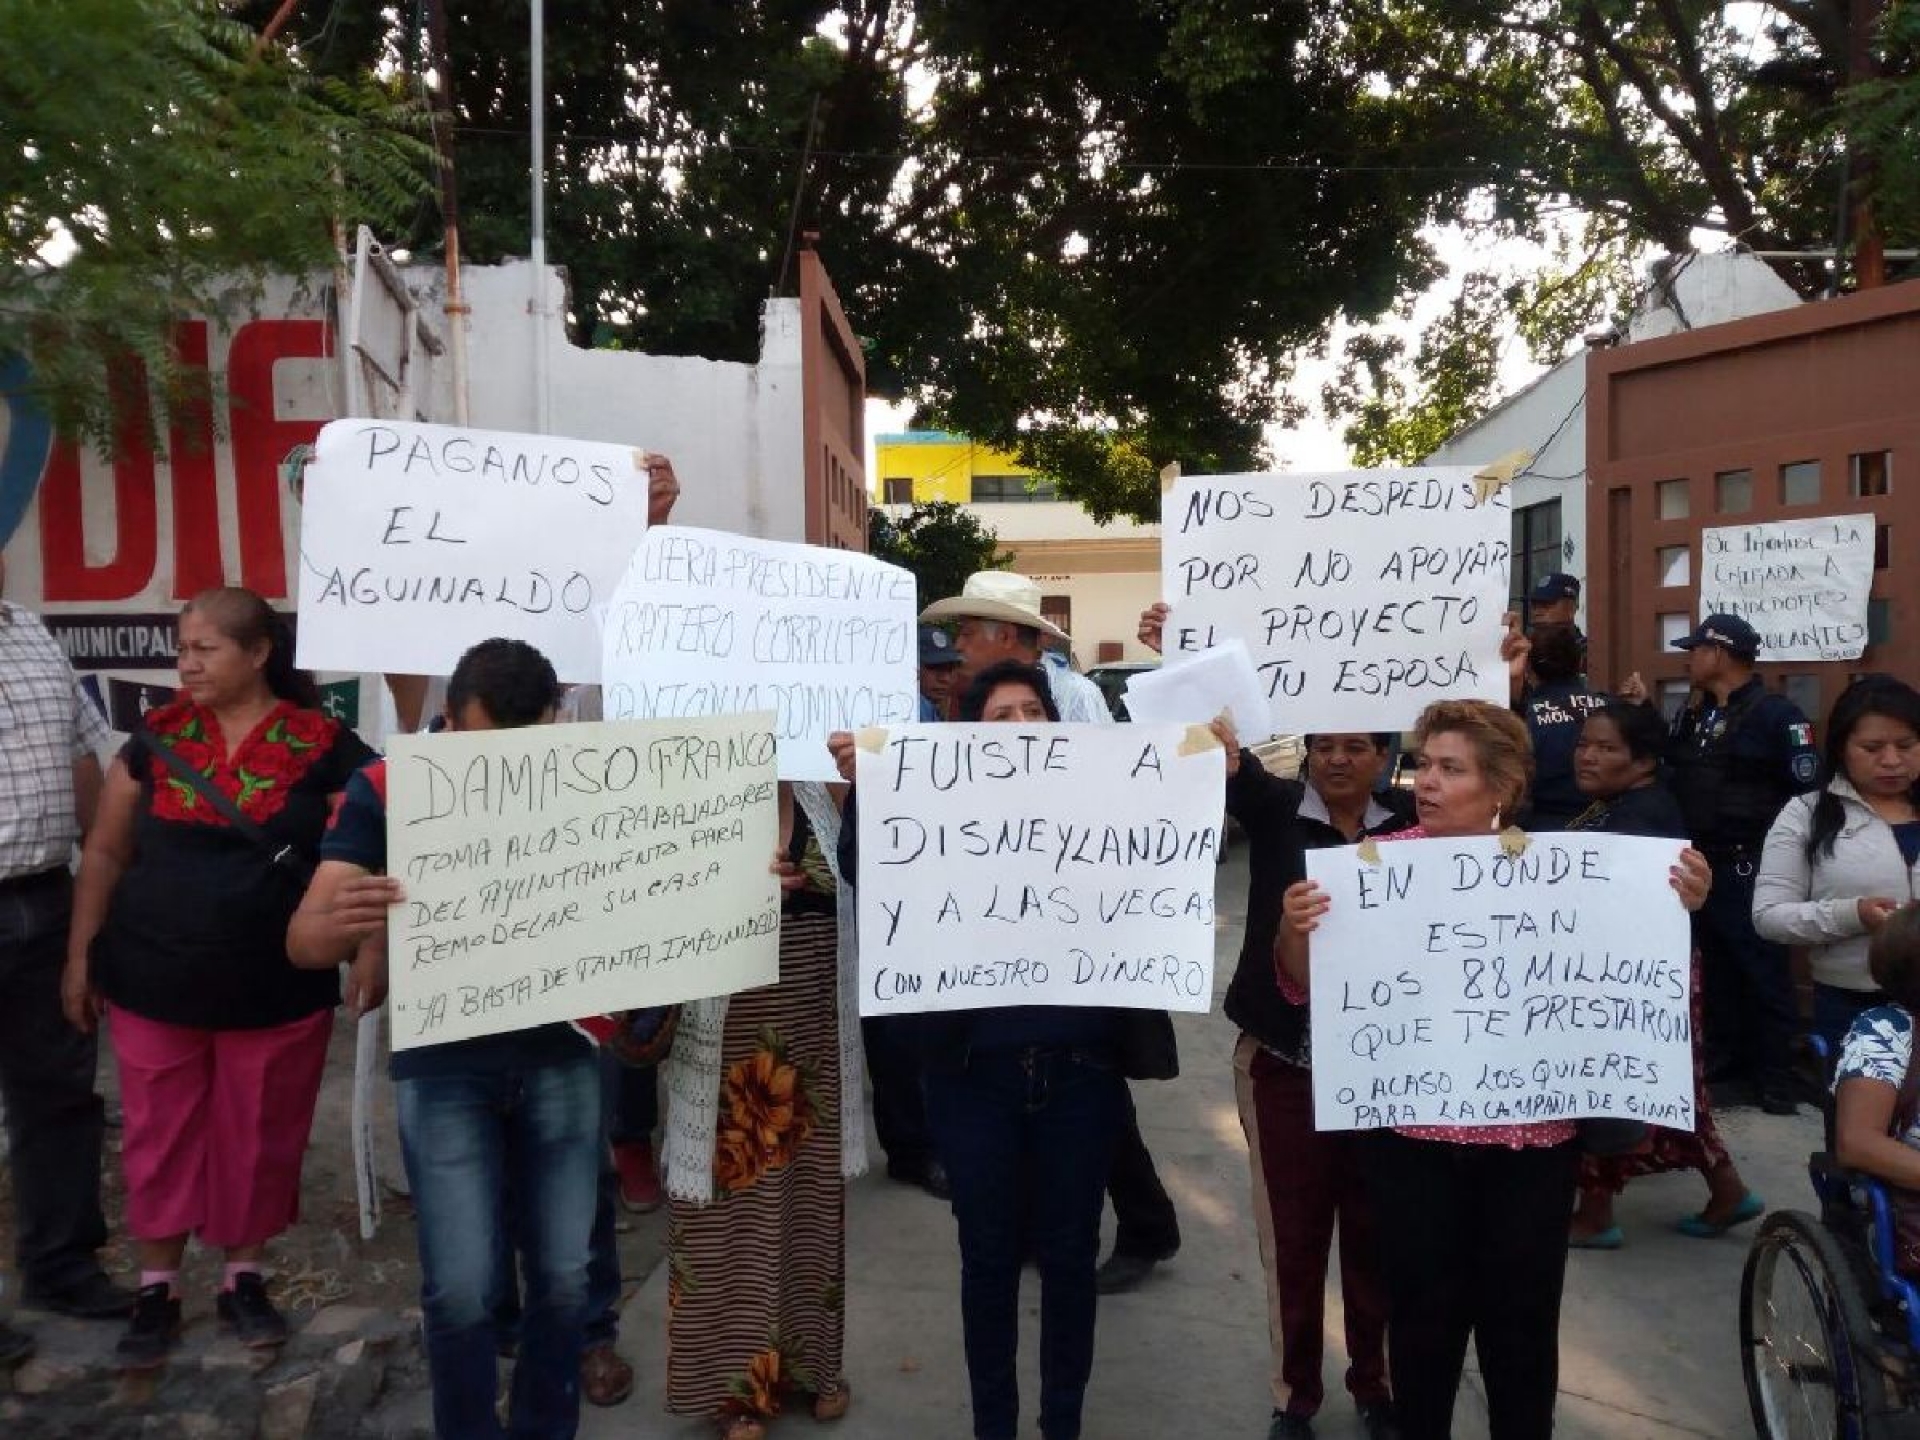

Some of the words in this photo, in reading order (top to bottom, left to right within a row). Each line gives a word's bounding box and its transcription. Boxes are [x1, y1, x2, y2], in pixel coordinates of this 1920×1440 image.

[32, 320, 334, 601] DIF
[357, 427, 614, 505] PAGANOS
[382, 506, 467, 544] EL
[1181, 489, 1273, 534] NOS
[317, 567, 591, 613] AGUINALDO
[723, 548, 914, 600] PRESIDENTE
[1180, 554, 1263, 596] POR
[1294, 550, 1351, 588] NO
[1380, 541, 1510, 586] APOYAR
[1825, 555, 1841, 576] A
[55, 626, 179, 656] MUNICIPAL
[616, 602, 734, 658] RATERO
[754, 611, 908, 664] CORRUPTO
[1262, 596, 1478, 647] PROYECTO
[1258, 660, 1306, 699] TU
[1333, 650, 1478, 697] ESPOSA
[405, 746, 639, 826] DAMASO
[649, 732, 776, 789] FRANCO
[1130, 743, 1163, 782] A
[408, 838, 491, 883] TOMA
[591, 782, 774, 841] TRABAJADORES
[879, 816, 1217, 874] DISNEYLANDIA
[410, 896, 466, 929] DEL
[691, 819, 744, 850] PARA
[602, 888, 637, 913] SU
[648, 862, 721, 899] CASA
[1357, 864, 1413, 910] EN
[1451, 847, 1610, 892] DONDE
[880, 899, 903, 946] Y
[937, 892, 961, 924] A
[983, 885, 1080, 925] LAS
[1100, 887, 1214, 926] VEGAS
[1427, 909, 1577, 953] ESTAN
[460, 978, 532, 1018] BASTA
[539, 967, 569, 994] DE
[576, 946, 651, 984] TANTA
[875, 967, 922, 1001] CON
[937, 957, 1049, 994] NUESTRO
[1342, 971, 1422, 1012] LOS
[1462, 956, 1512, 999] 88
[1524, 952, 1684, 999] MILLONES
[1351, 1018, 1433, 1062] QUE
[1453, 1009, 1510, 1044] TE
[1523, 994, 1689, 1043] PRESTARON
[1371, 1070, 1452, 1099] ACASO
[1476, 1063, 1526, 1089] LOS
[1532, 1053, 1659, 1084] QUIERES
[1355, 1103, 1418, 1127] PARA
[1587, 1091, 1613, 1111] DE
